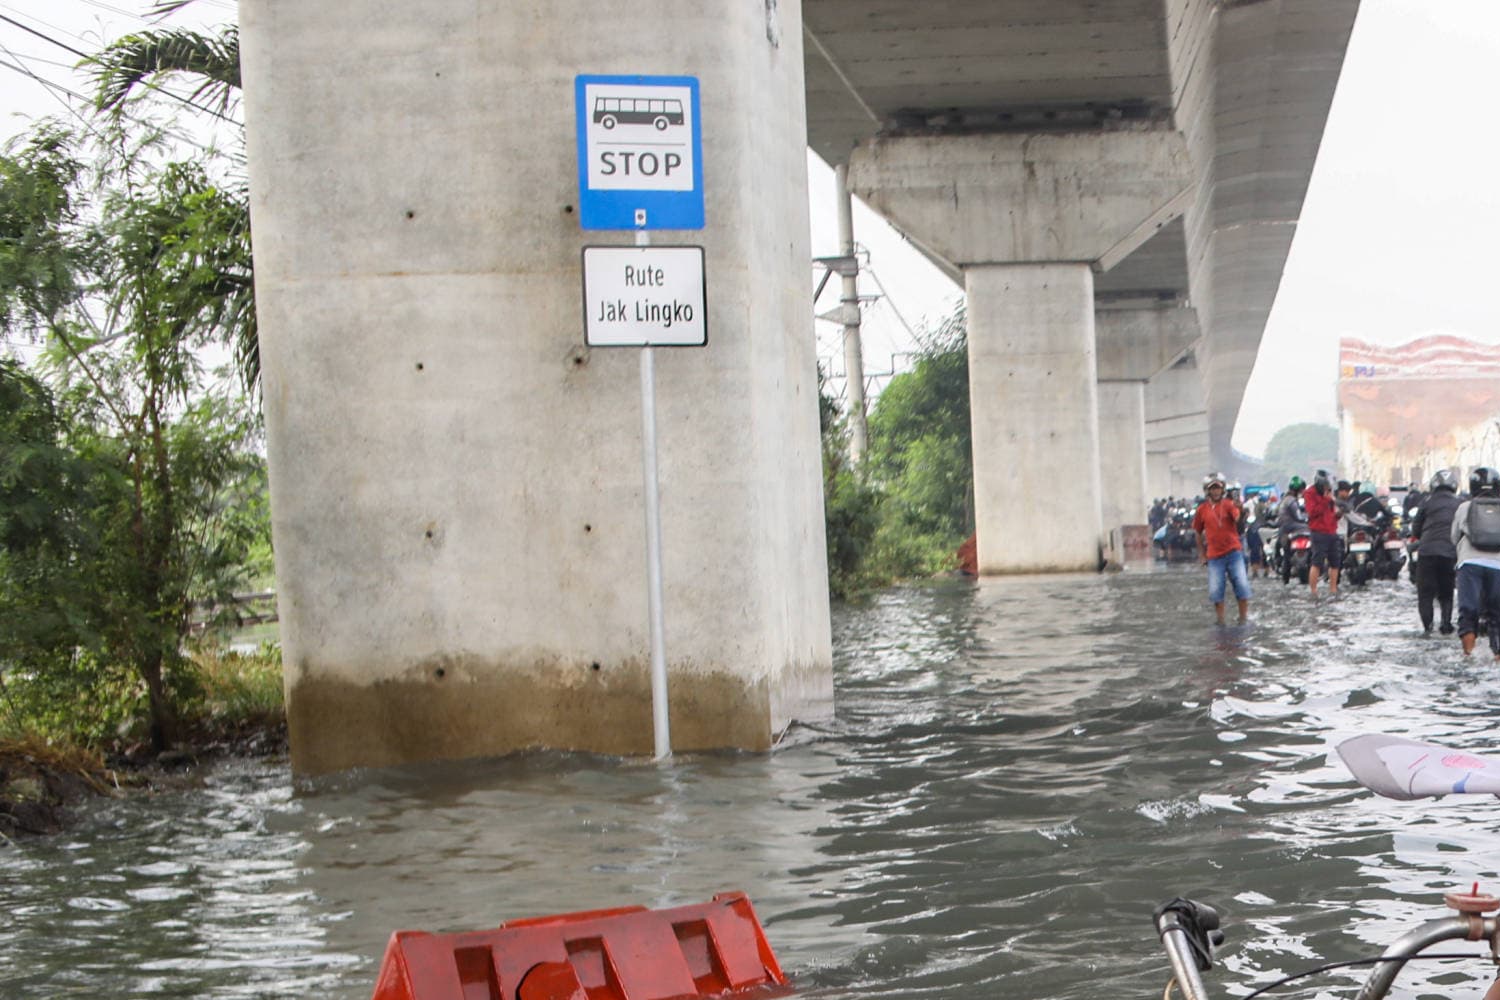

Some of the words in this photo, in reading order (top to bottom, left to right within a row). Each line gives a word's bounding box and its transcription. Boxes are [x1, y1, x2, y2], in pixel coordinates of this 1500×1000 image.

[600, 152, 682, 176] STOP
[625, 265, 664, 287] Rute
[598, 300, 626, 322] Jak
[636, 299, 693, 328] Lingko
